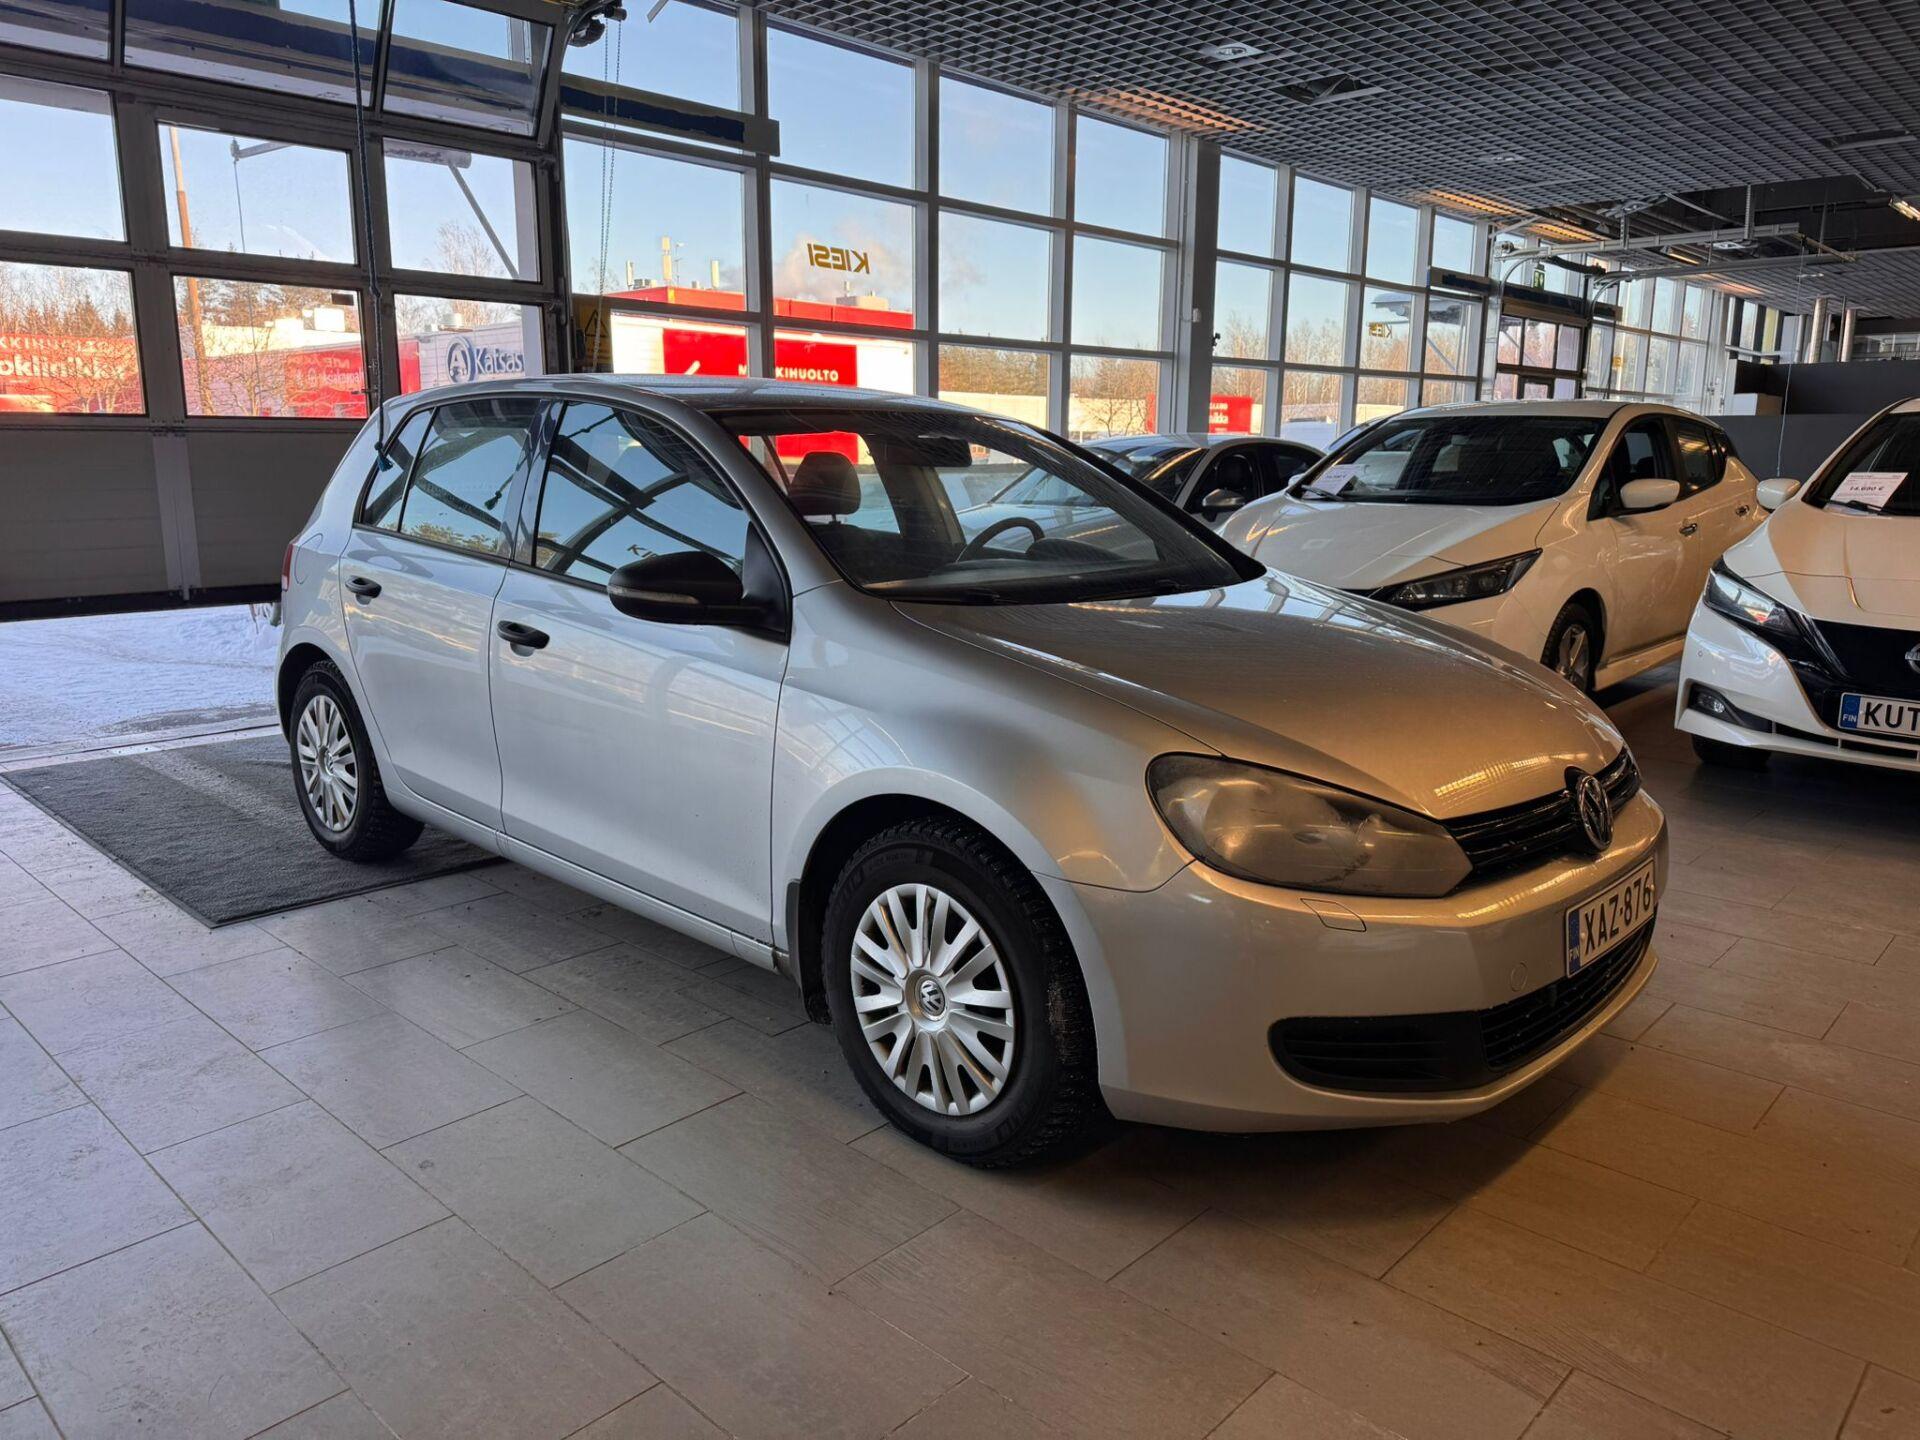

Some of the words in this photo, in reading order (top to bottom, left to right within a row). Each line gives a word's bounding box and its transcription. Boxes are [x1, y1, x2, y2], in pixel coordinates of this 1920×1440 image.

[1842, 713, 1857, 722] FIN
[1863, 701, 1920, 731] KUT
[1584, 871, 1651, 956] XAZ-876
